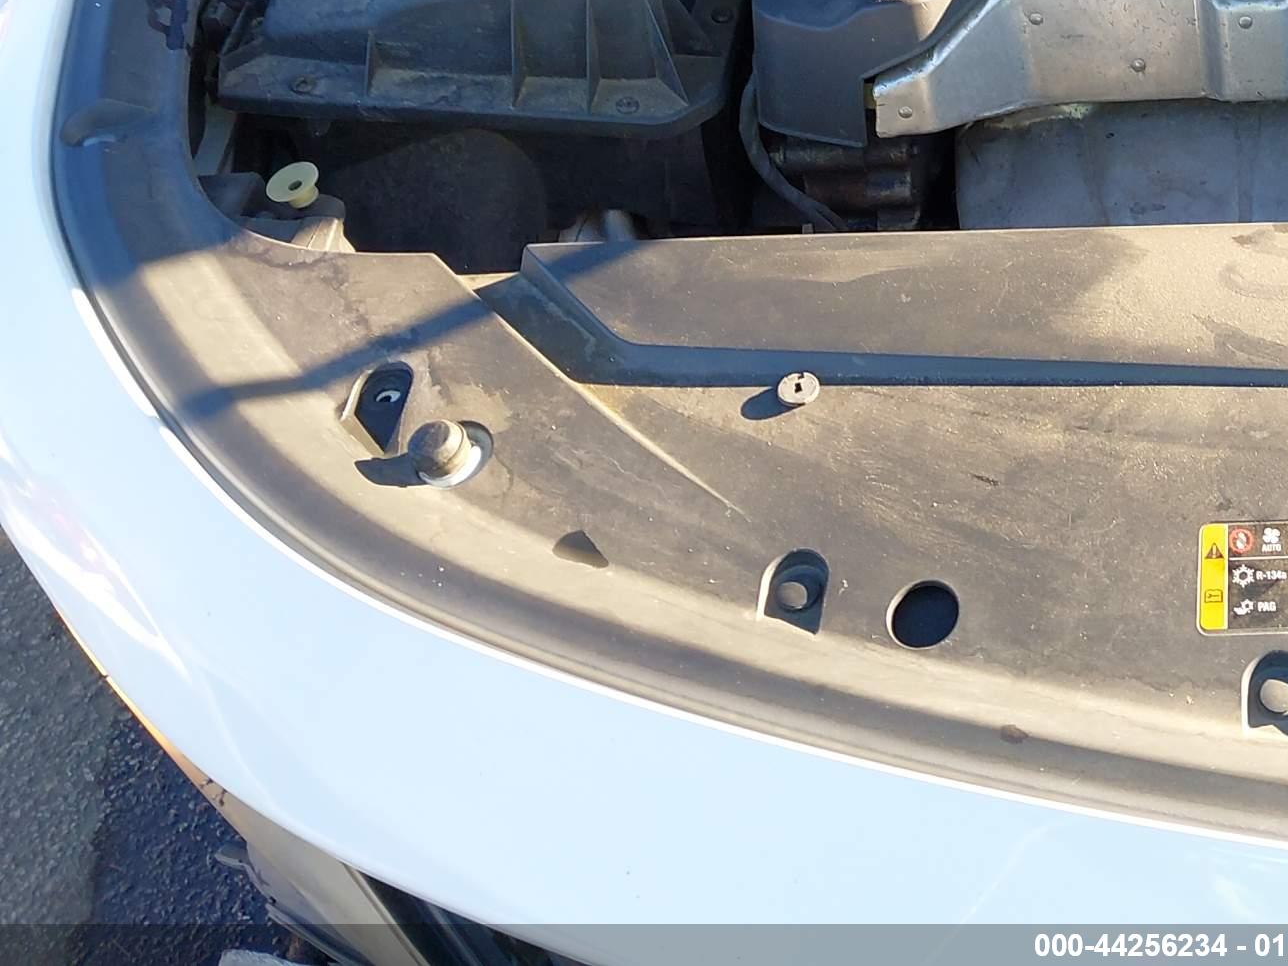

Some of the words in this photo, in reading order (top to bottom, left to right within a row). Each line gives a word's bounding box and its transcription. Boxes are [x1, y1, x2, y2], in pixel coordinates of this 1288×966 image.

[1261, 544, 1282, 552] AUTO
[1256, 570, 1287, 580] R-134a
[1257, 602, 1277, 612] PAG
